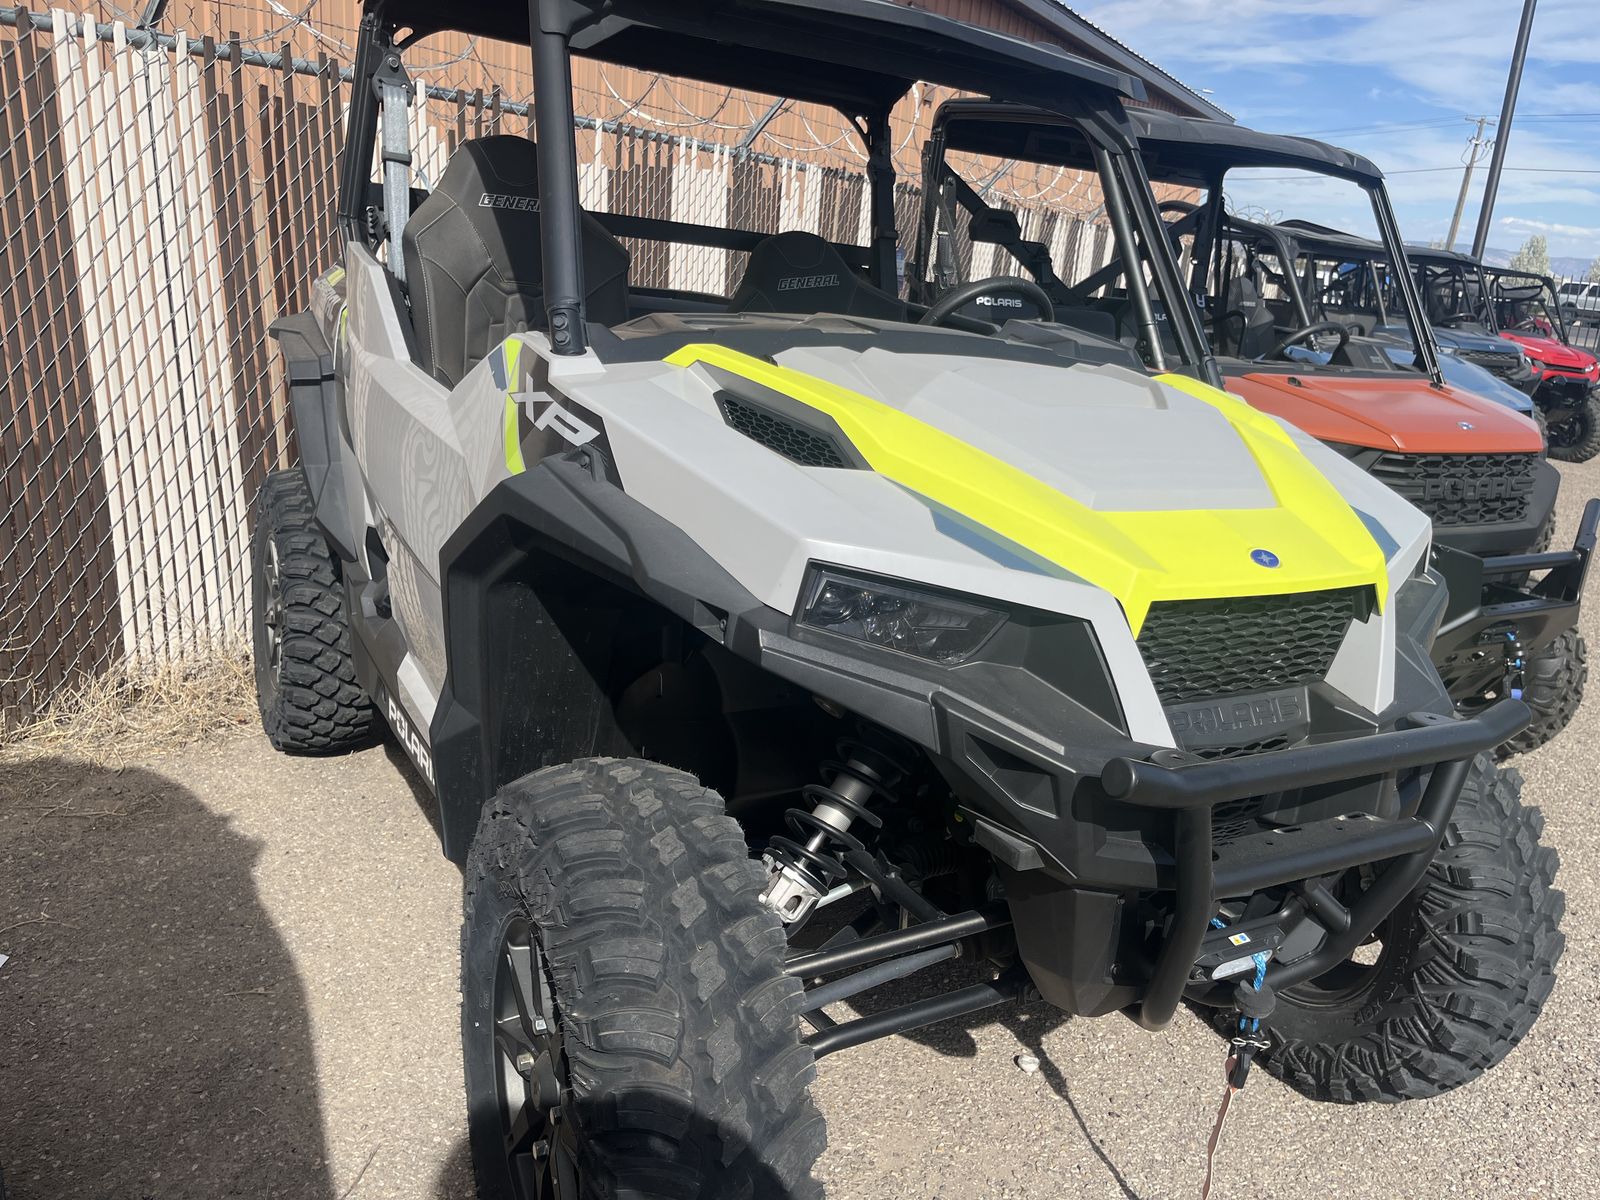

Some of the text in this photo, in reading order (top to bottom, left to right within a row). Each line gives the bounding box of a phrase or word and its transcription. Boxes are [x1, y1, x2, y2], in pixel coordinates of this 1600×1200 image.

[478, 193, 541, 212] GENER
[777, 274, 840, 291] GENERAL
[976, 296, 1022, 308] POLARIS
[508, 371, 601, 447] XP
[1424, 477, 1534, 500] POLARIS
[1168, 695, 1302, 735] POLARIS
[388, 696, 435, 786] POLARI
